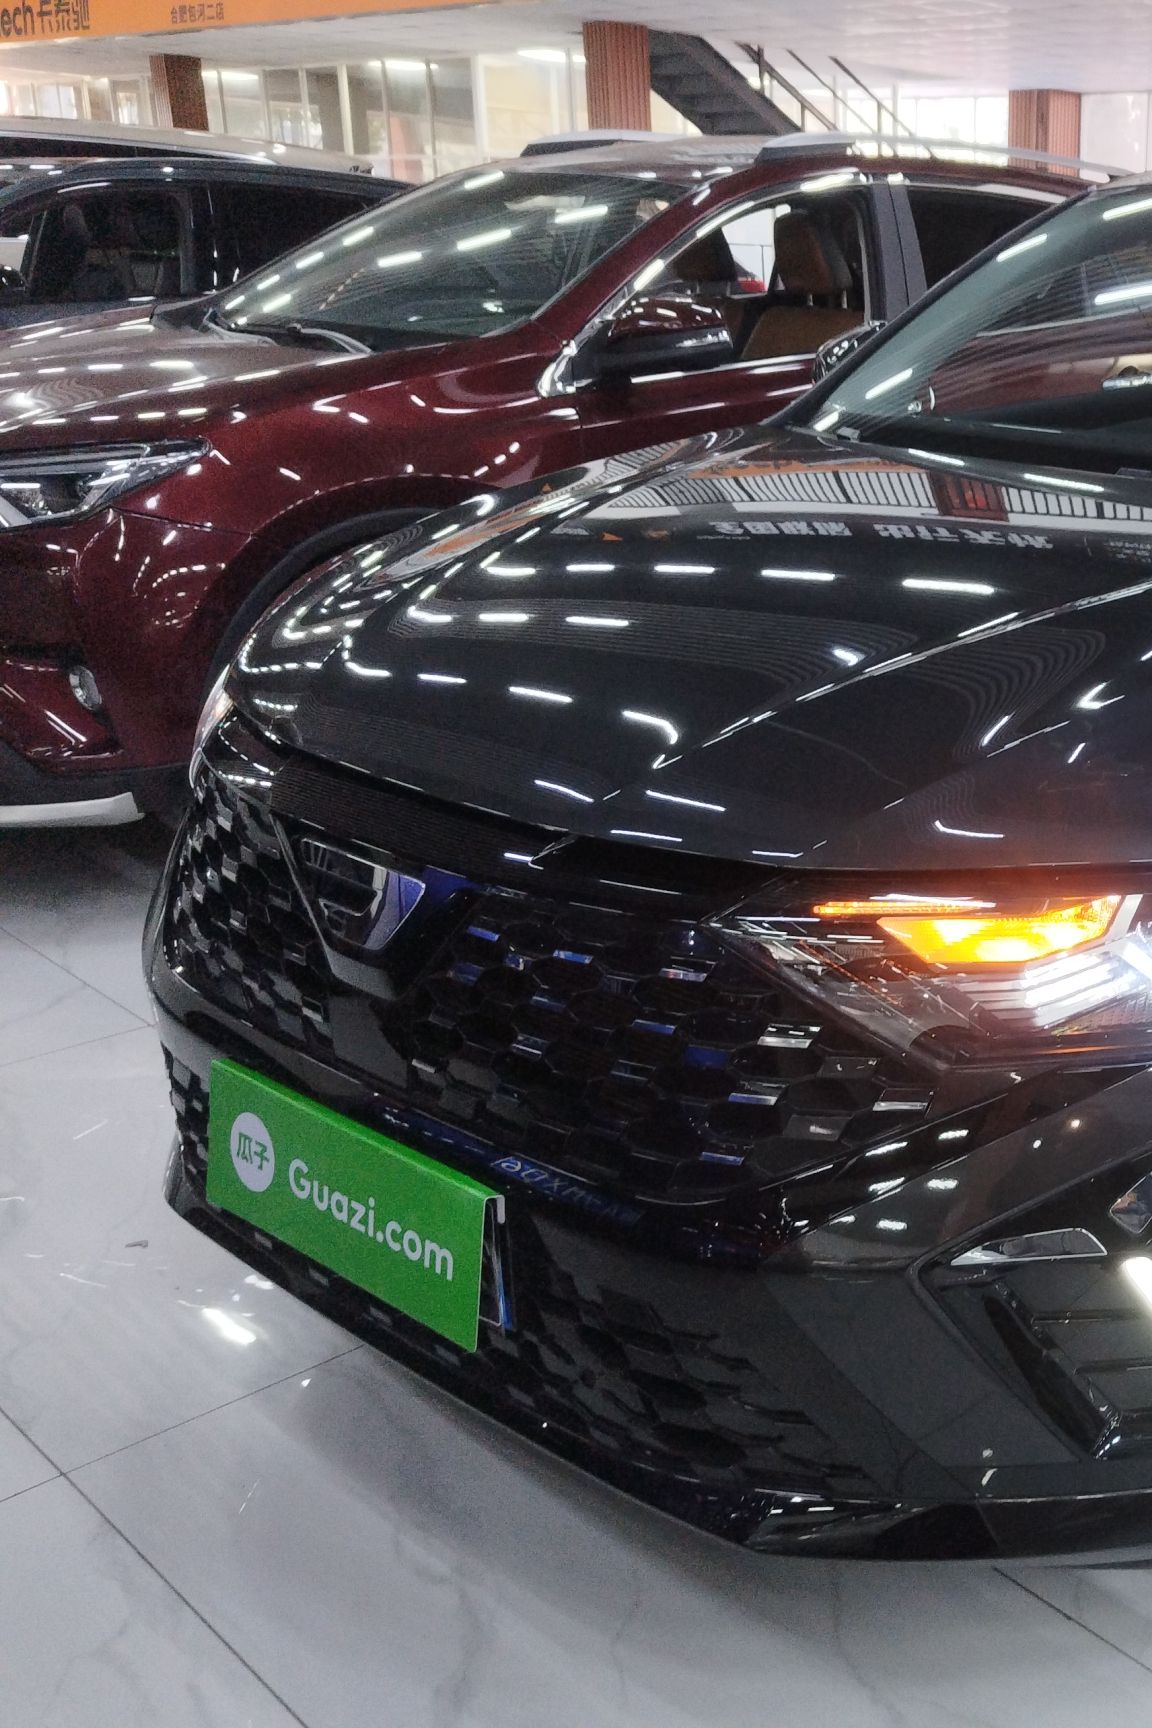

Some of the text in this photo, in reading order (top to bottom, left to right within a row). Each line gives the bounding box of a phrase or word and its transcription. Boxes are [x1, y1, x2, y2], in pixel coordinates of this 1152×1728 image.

[0, 0, 35, 37] ech
[236, 1132, 270, 1171] 瓜子
[288, 1158, 454, 1281] Guazi.com
